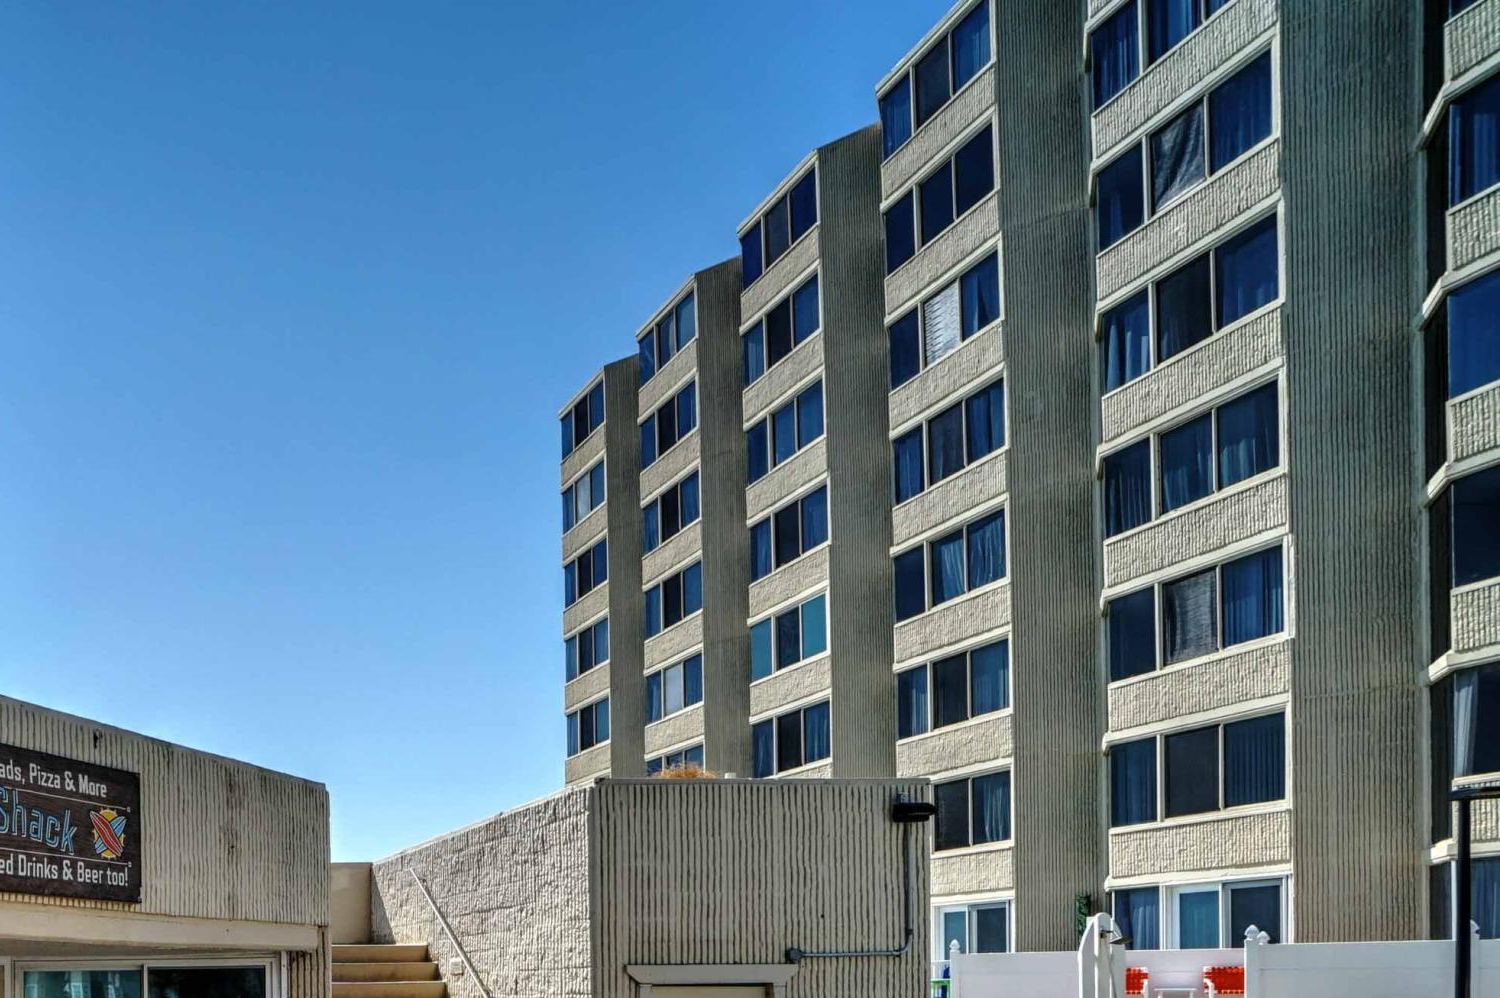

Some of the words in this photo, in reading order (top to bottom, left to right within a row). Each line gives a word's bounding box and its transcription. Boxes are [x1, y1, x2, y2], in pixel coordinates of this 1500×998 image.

[29, 763, 61, 790] Pizza
[65, 772, 76, 792] &
[78, 777, 107, 798] More
[18, 855, 58, 880] Drinks
[62, 862, 73, 881] &
[77, 865, 102, 884] Beer
[106, 867, 129, 887] too!
